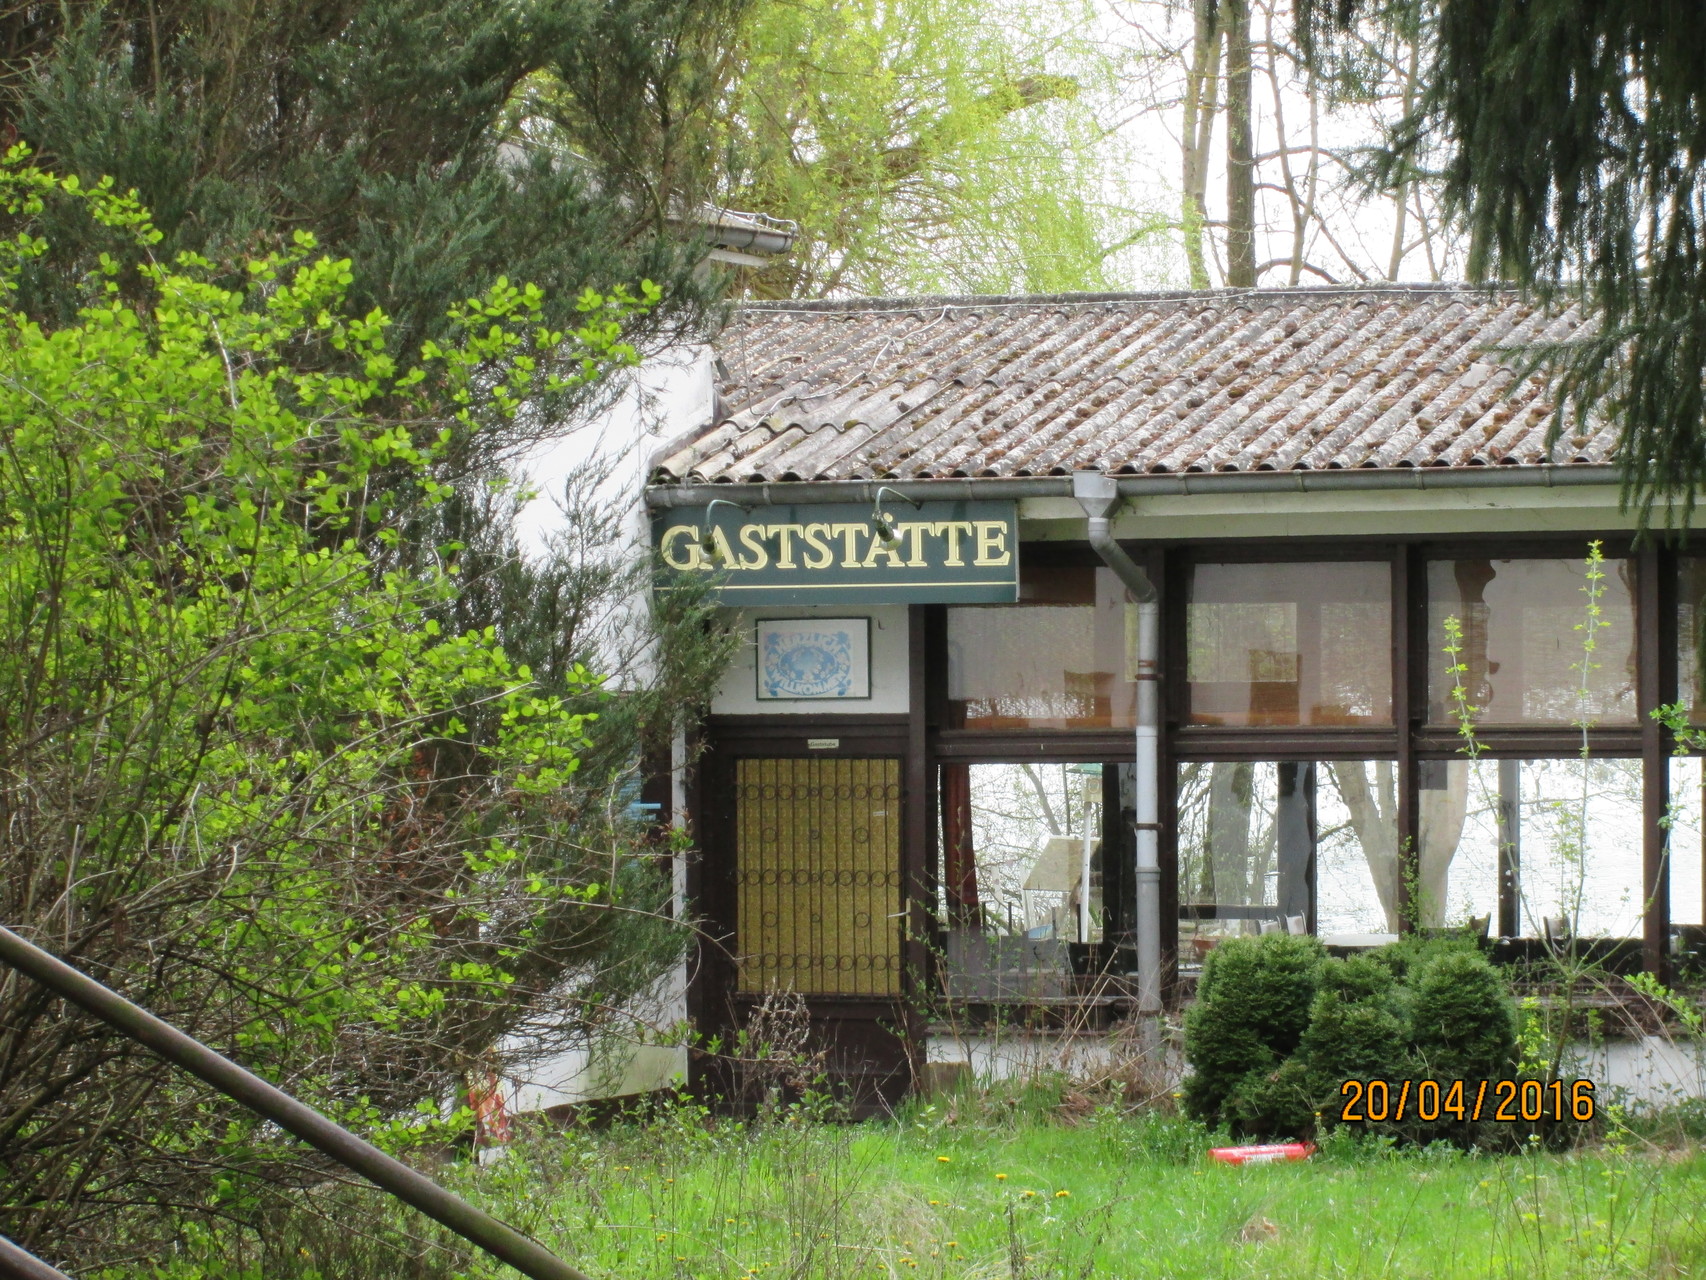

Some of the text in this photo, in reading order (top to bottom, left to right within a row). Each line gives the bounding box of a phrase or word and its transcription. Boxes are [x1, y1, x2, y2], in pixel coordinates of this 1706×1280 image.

[661, 512, 1011, 571] GASTSTÄTTE
[774, 631, 847, 654] HERZLICH
[769, 669, 848, 695] WILLKOMMEN
